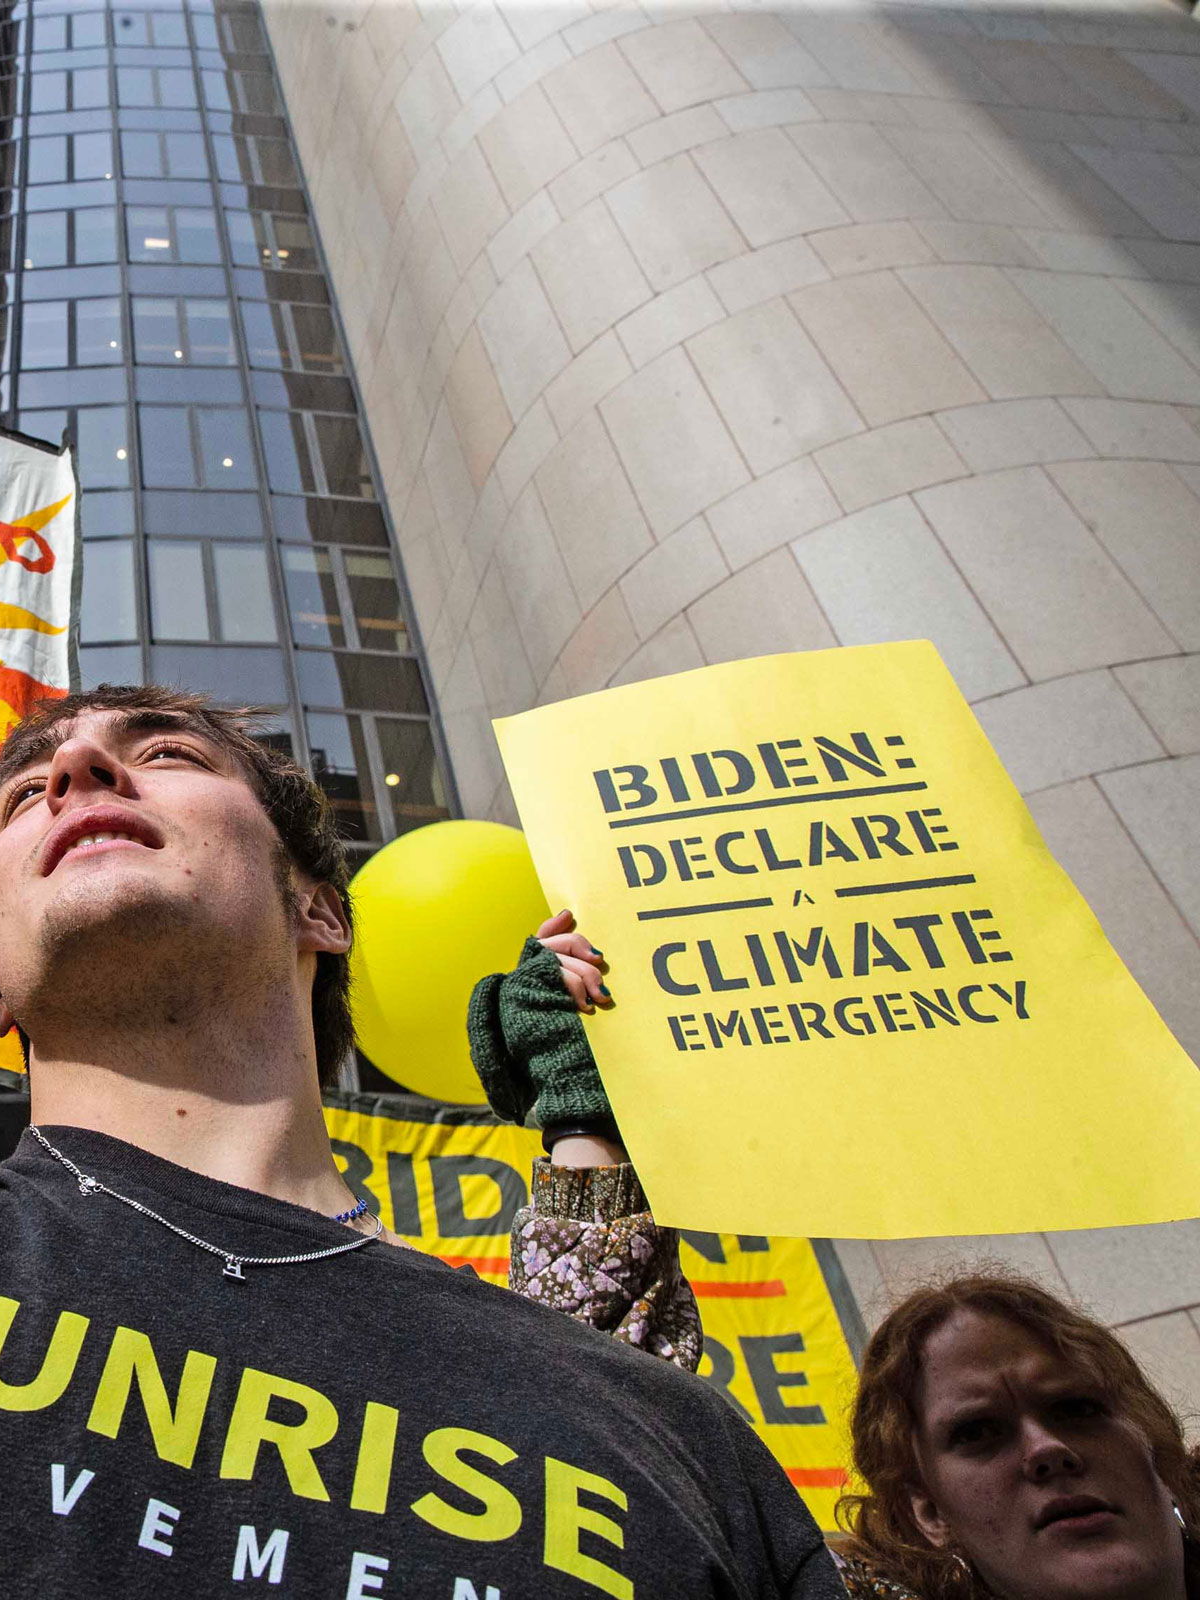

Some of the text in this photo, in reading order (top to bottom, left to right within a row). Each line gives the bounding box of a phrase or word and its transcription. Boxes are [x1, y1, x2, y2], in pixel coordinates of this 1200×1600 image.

[593, 731, 917, 815] BIDEN:
[617, 807, 960, 888] DECLARE
[652, 908, 1013, 997] CLIMATE
[667, 980, 1030, 1051] EMERGENCY
